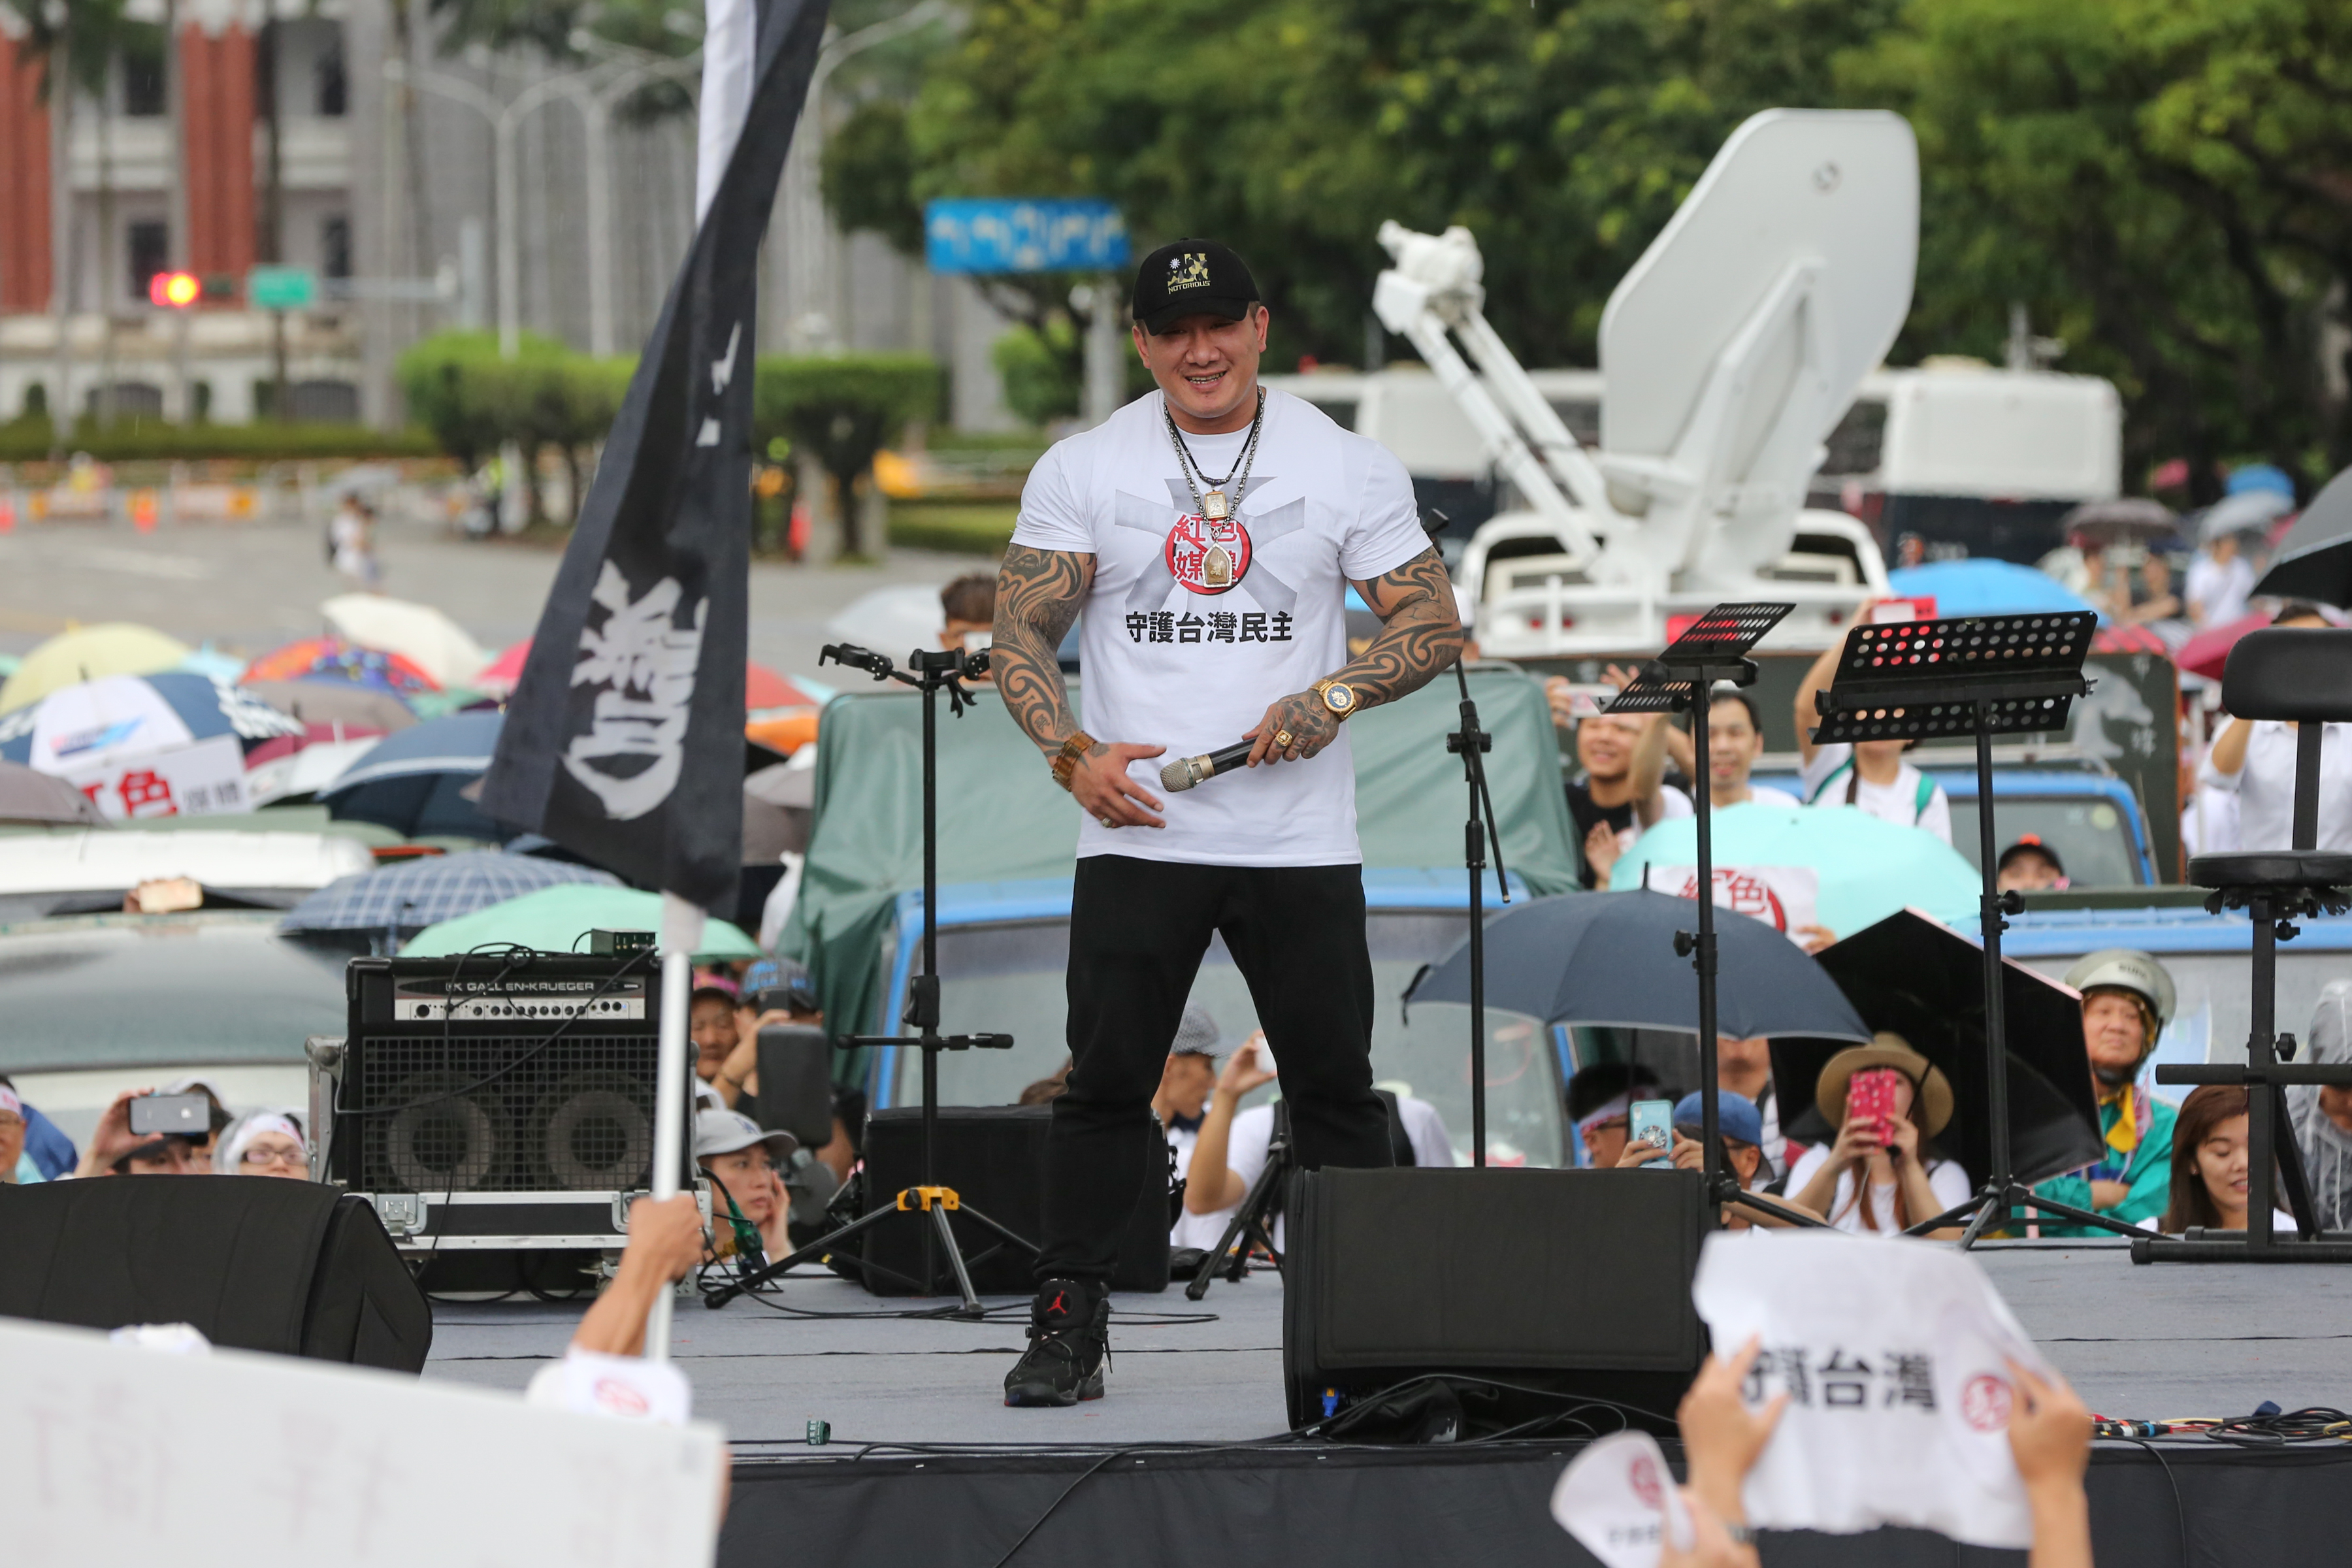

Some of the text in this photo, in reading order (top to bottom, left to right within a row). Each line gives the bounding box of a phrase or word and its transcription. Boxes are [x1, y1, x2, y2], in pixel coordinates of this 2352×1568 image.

[1168, 280, 1211, 295] NOTORIOUS
[1176, 550, 1237, 582] 媒
[1126, 611, 1293, 644] 守護台灣民主
[80, 766, 180, 818] 色
